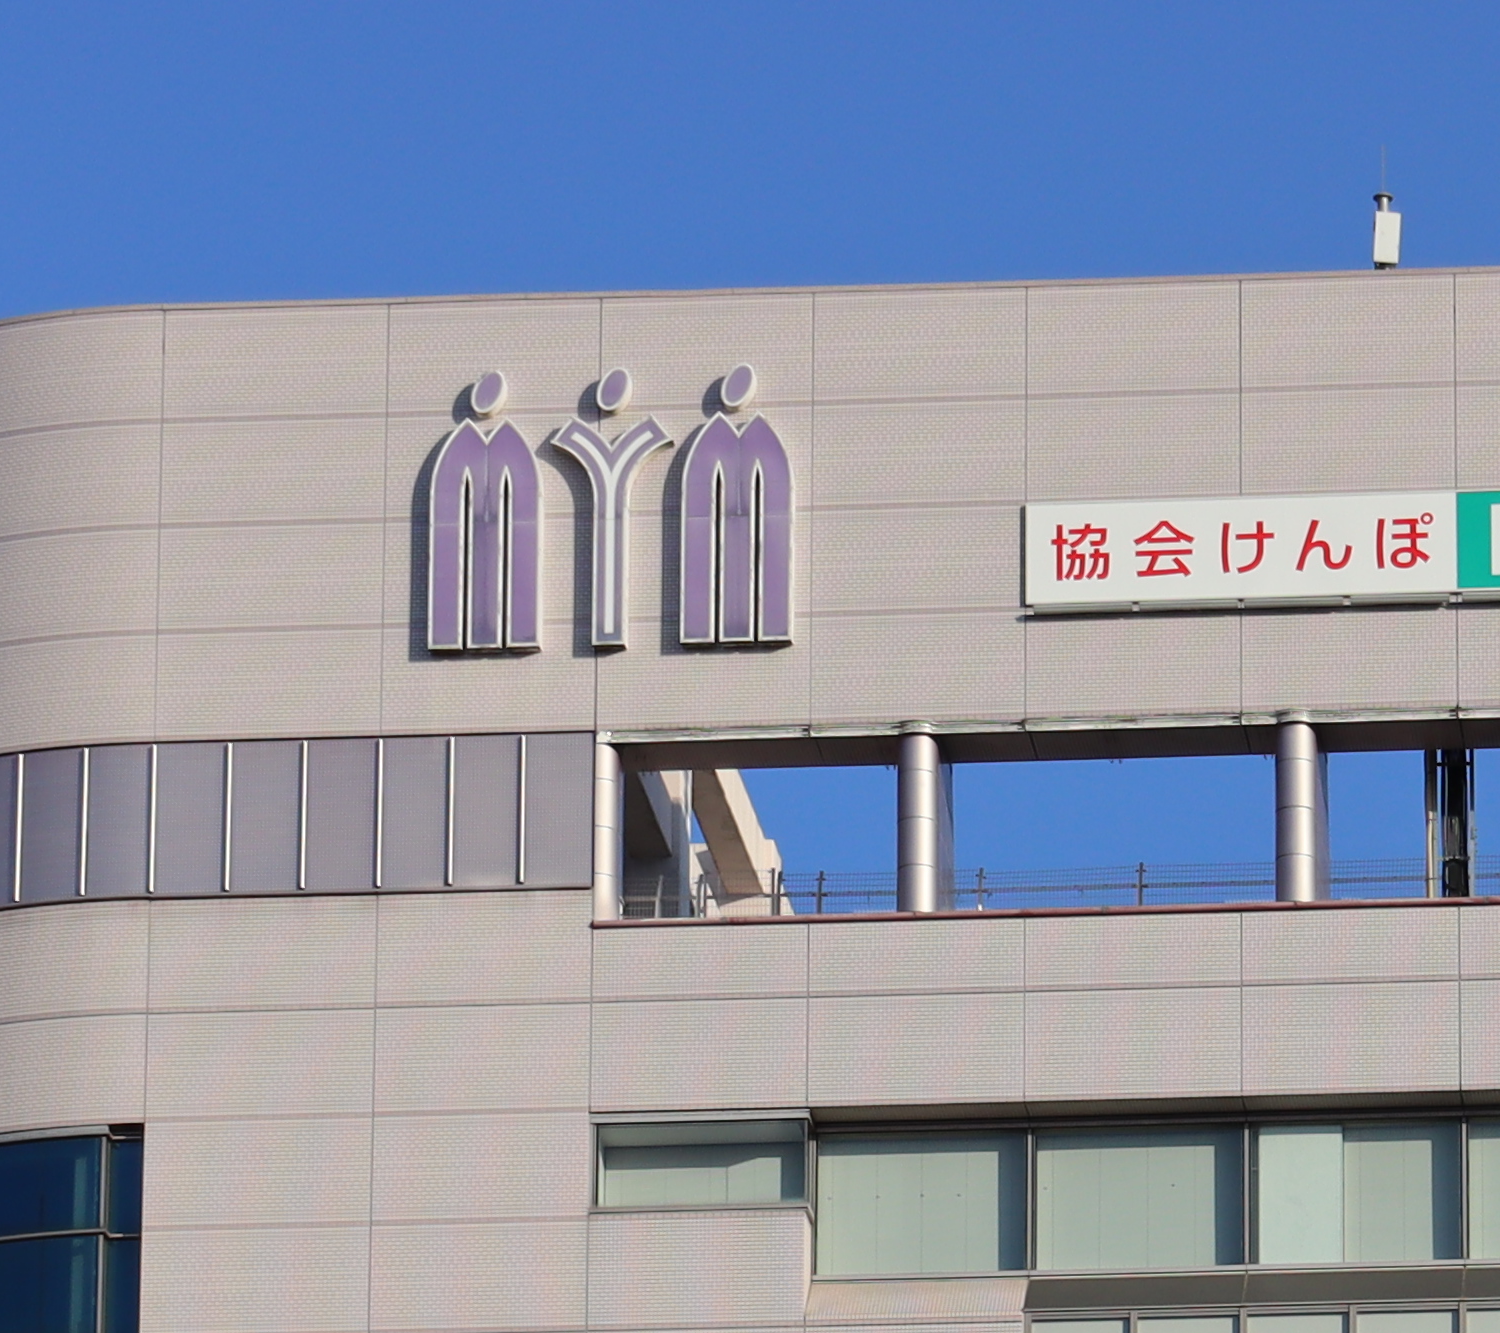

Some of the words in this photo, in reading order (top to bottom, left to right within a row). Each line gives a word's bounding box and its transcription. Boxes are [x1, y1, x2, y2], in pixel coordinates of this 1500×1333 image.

[1051, 512, 1437, 582] 協会けんぽ
